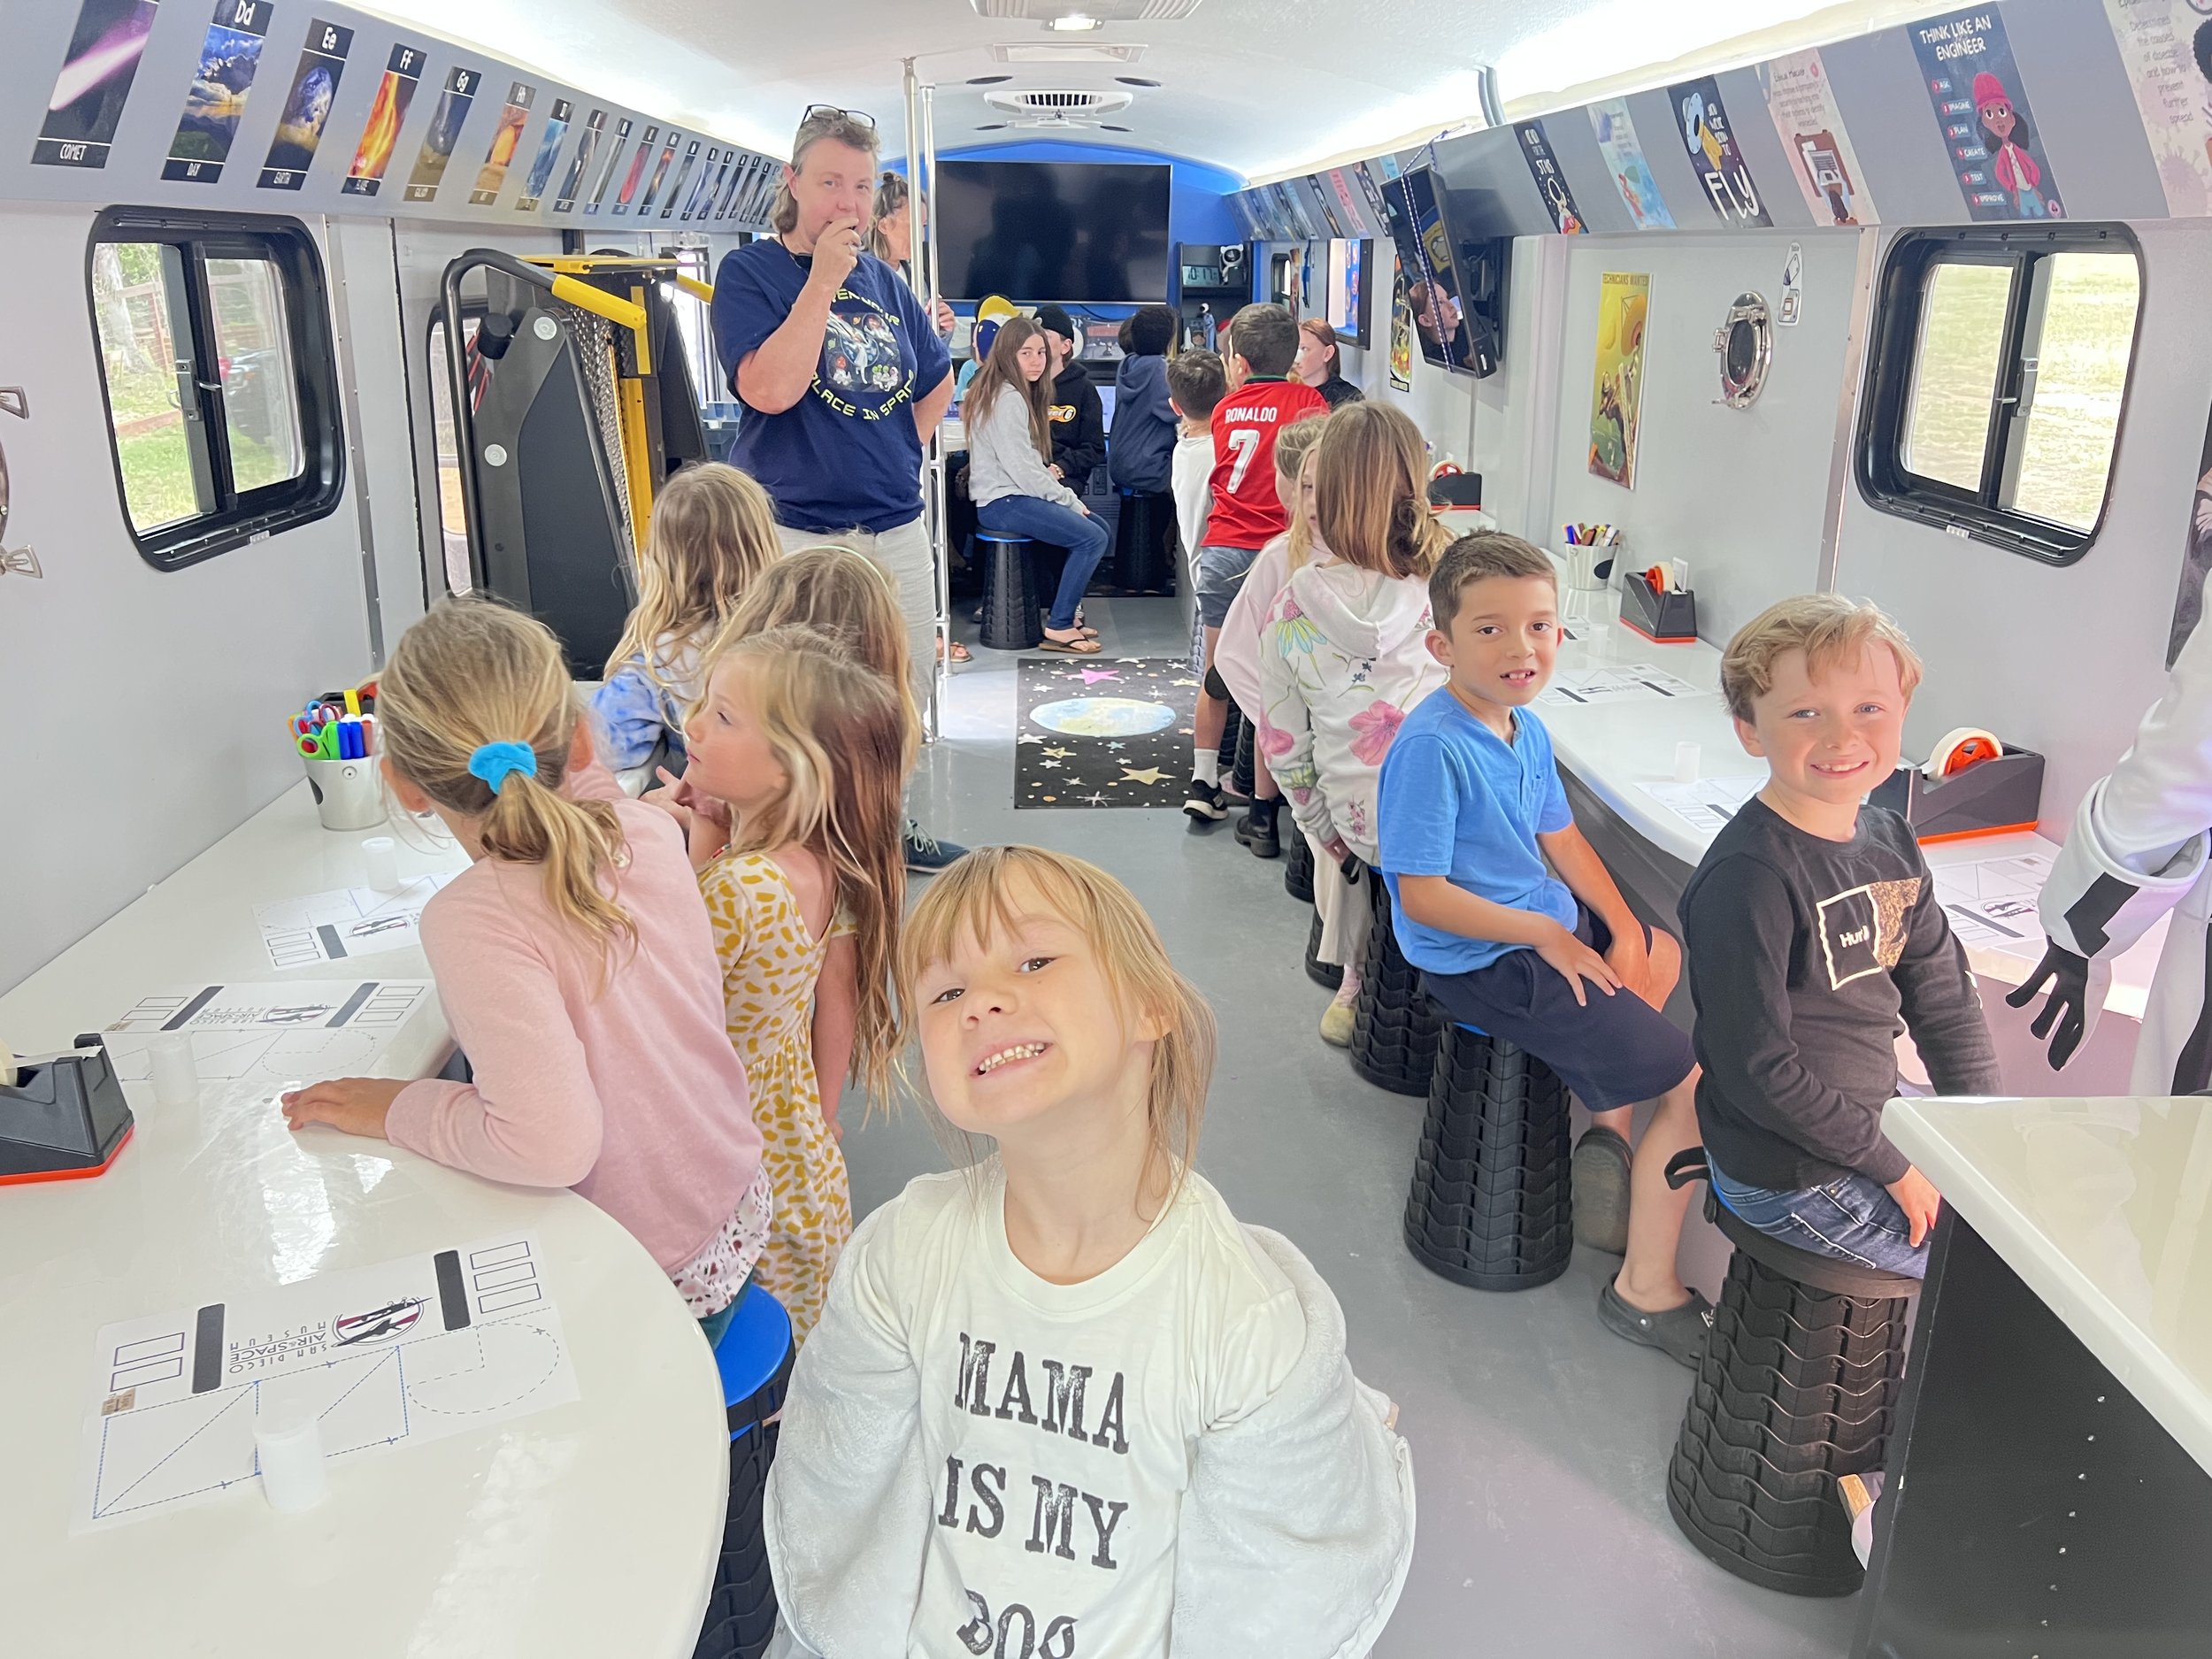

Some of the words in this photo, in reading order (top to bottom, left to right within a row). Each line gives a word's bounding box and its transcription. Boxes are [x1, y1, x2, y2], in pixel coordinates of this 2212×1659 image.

[234, 0, 256, 26] Dd
[322, 27, 337, 50] Ee
[1919, 25, 1951, 44] THINK
[1950, 19, 1974, 37] LIKE
[1975, 14, 1992, 32] AN
[1936, 37, 1986, 61] ENGINEER
[399, 50, 413, 70] Ff
[457, 71, 470, 92] Gg
[1948, 100, 1971, 111] IMAGINE
[1954, 126, 1969, 134] PLAN
[59, 143, 87, 161] COMET
[1964, 148, 1985, 157] CREATE
[187, 163, 201, 177] DAY
[1970, 173, 1984, 181] TEST
[1979, 194, 2005, 203] IMPROVE
[862, 408, 880, 420] IN
[1225, 406, 1278, 425] RONALDO
[1226, 429, 1260, 495] 7
[230, 1321, 326, 1351] MUSEUM
[955, 1332, 1129, 1455] MAMA
[938, 1452, 1006, 1539] IS
[1025, 1474, 1129, 1570] MY
